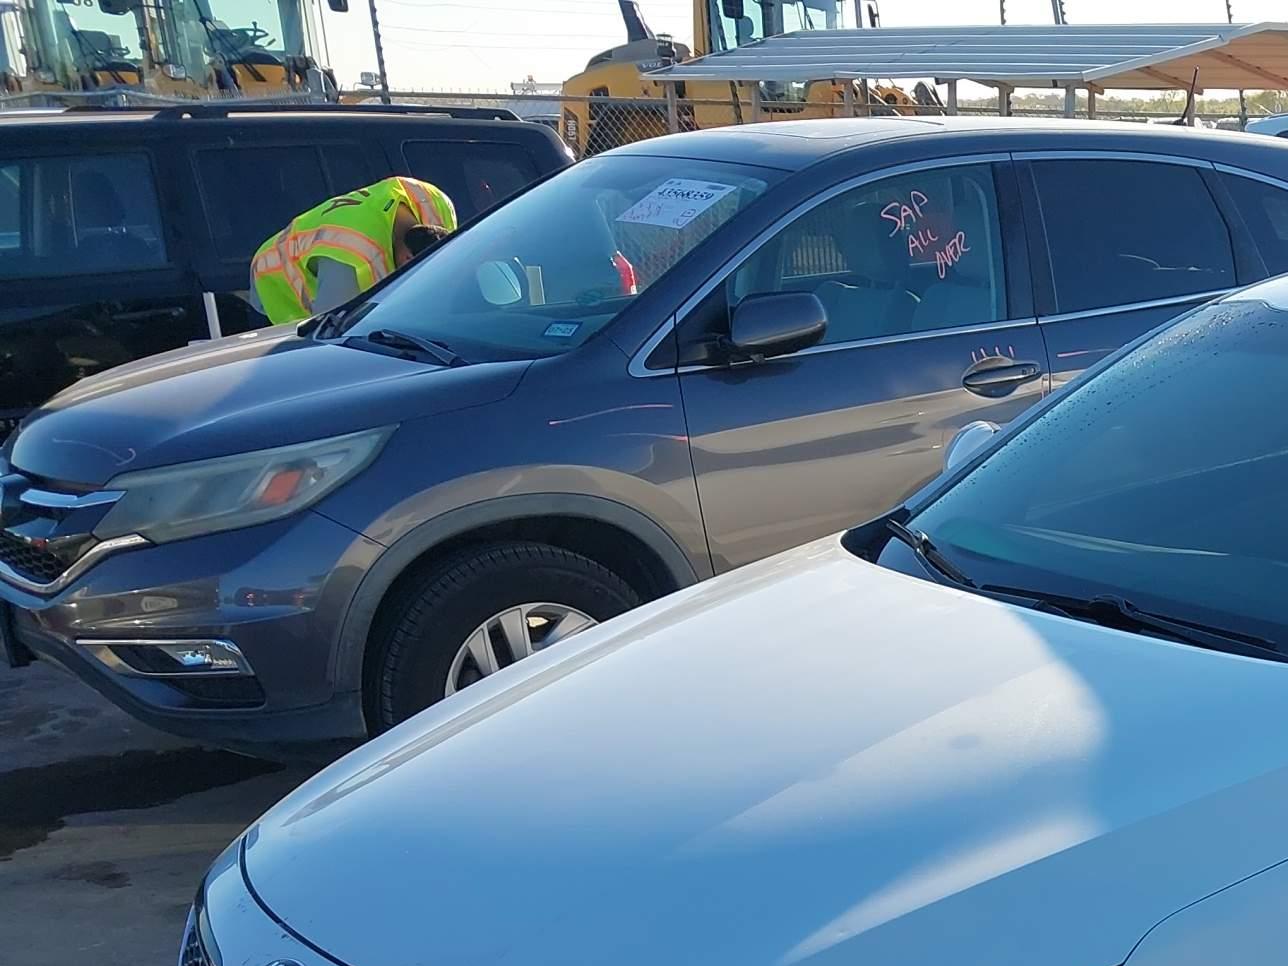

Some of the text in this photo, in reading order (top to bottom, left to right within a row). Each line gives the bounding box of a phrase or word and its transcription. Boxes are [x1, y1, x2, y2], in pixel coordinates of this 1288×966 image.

[881, 190, 927, 237] SAP
[909, 229, 938, 256] ALL
[936, 232, 970, 279] OVER
